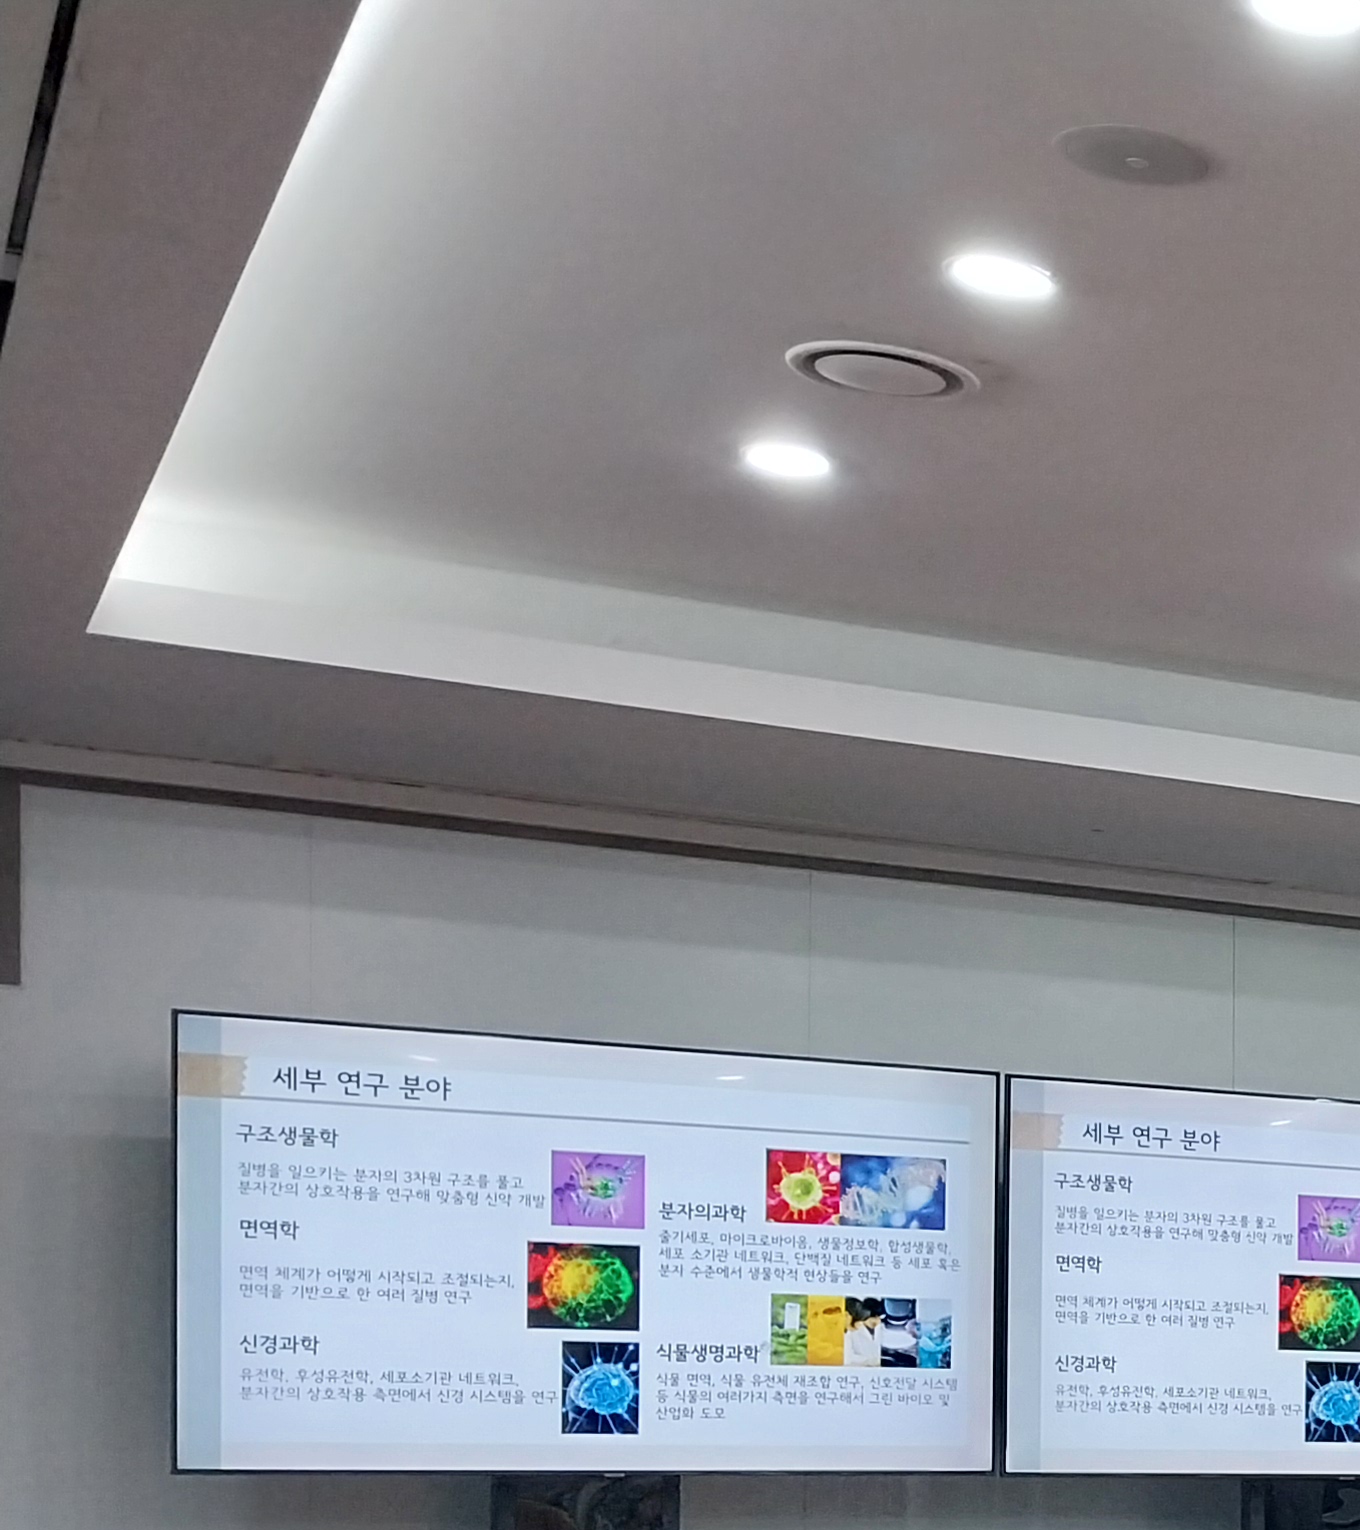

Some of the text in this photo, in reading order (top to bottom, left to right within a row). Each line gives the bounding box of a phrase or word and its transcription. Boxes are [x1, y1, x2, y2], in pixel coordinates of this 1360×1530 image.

[273, 1065, 451, 1102] 세부 연구 분야
[236, 1123, 338, 1148] 구조생물학
[1082, 1121, 1220, 1152] 세부 연구 분야
[1054, 1171, 1132, 1193] 구조생물학
[658, 1200, 746, 1223] 분자의과학
[239, 1218, 299, 1240] 면역학
[1056, 1254, 1102, 1273] 면역학
[240, 1334, 319, 1355] 신경과학
[657, 1342, 761, 1364] 식물생명과학
[1055, 1354, 1116, 1373] 신경과학
